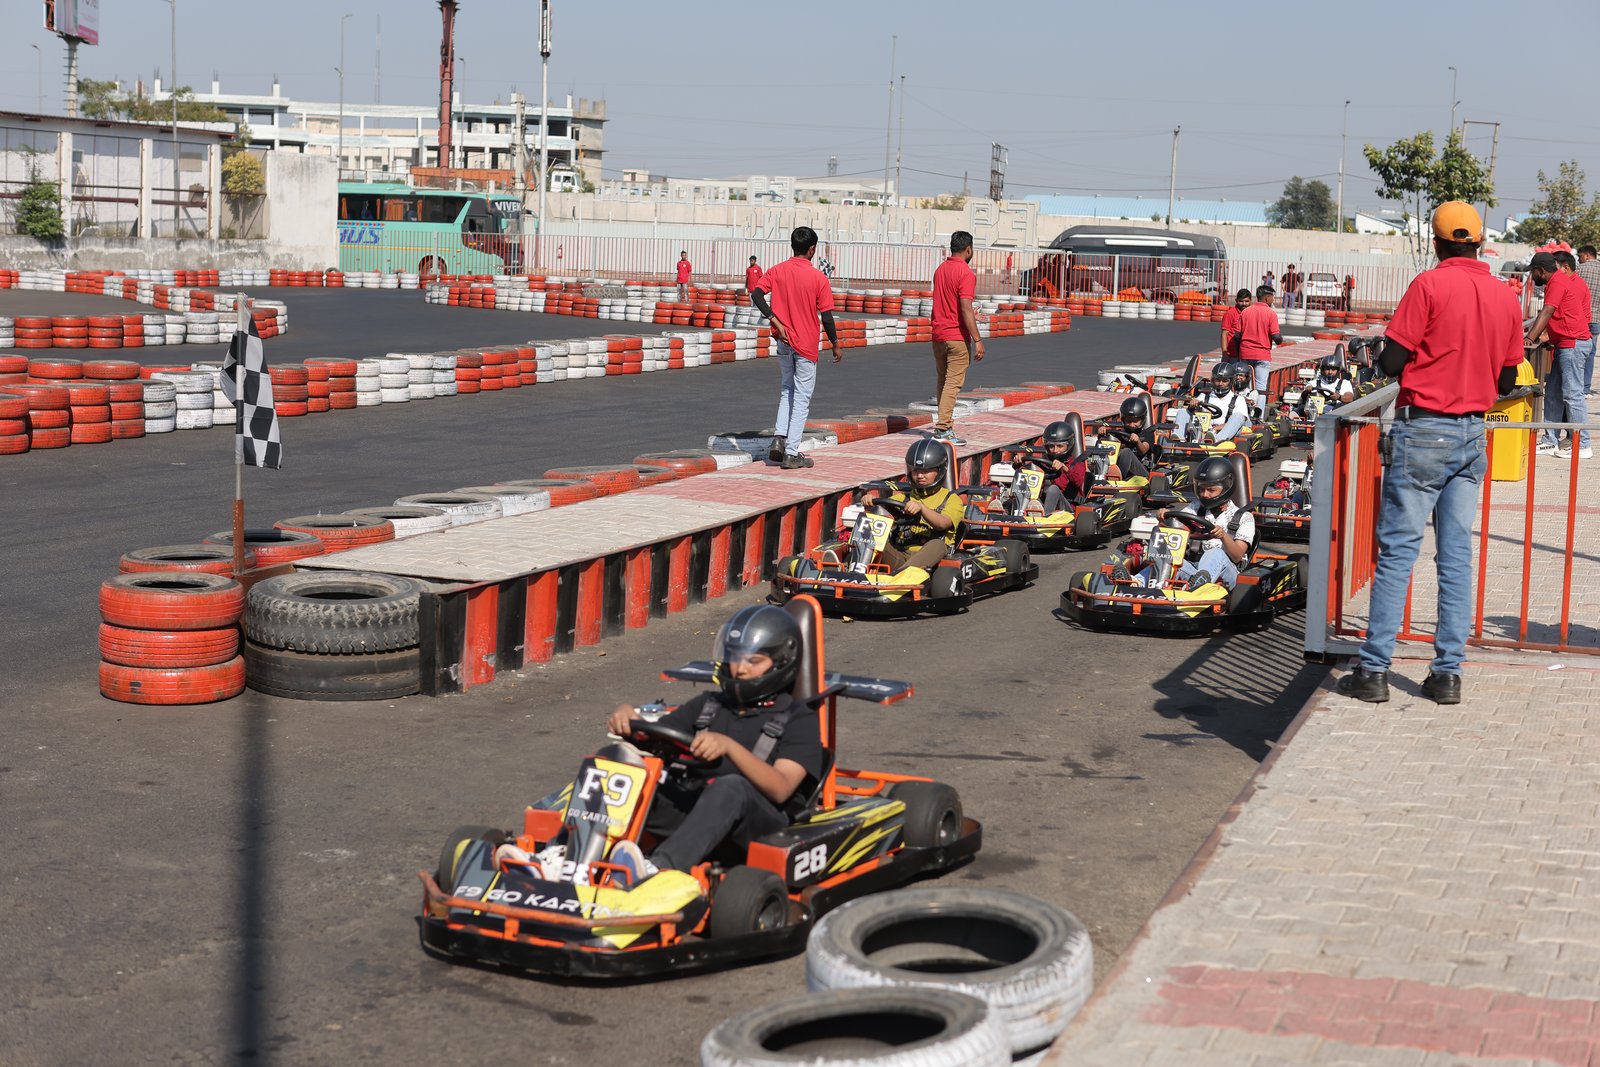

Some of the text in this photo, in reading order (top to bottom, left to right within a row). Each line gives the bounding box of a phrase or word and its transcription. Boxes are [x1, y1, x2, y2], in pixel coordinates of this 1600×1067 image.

[1016, 473, 1039, 488] F9
[858, 517, 887, 537] F9
[1153, 532, 1182, 551] F9
[849, 562, 868, 574] 15
[961, 564, 973, 580] 15
[578, 767, 633, 808] F9
[568, 808, 580, 817] GO
[794, 843, 827, 881] 28
[453, 885, 483, 899] F9
[486, 888, 522, 903] GO
